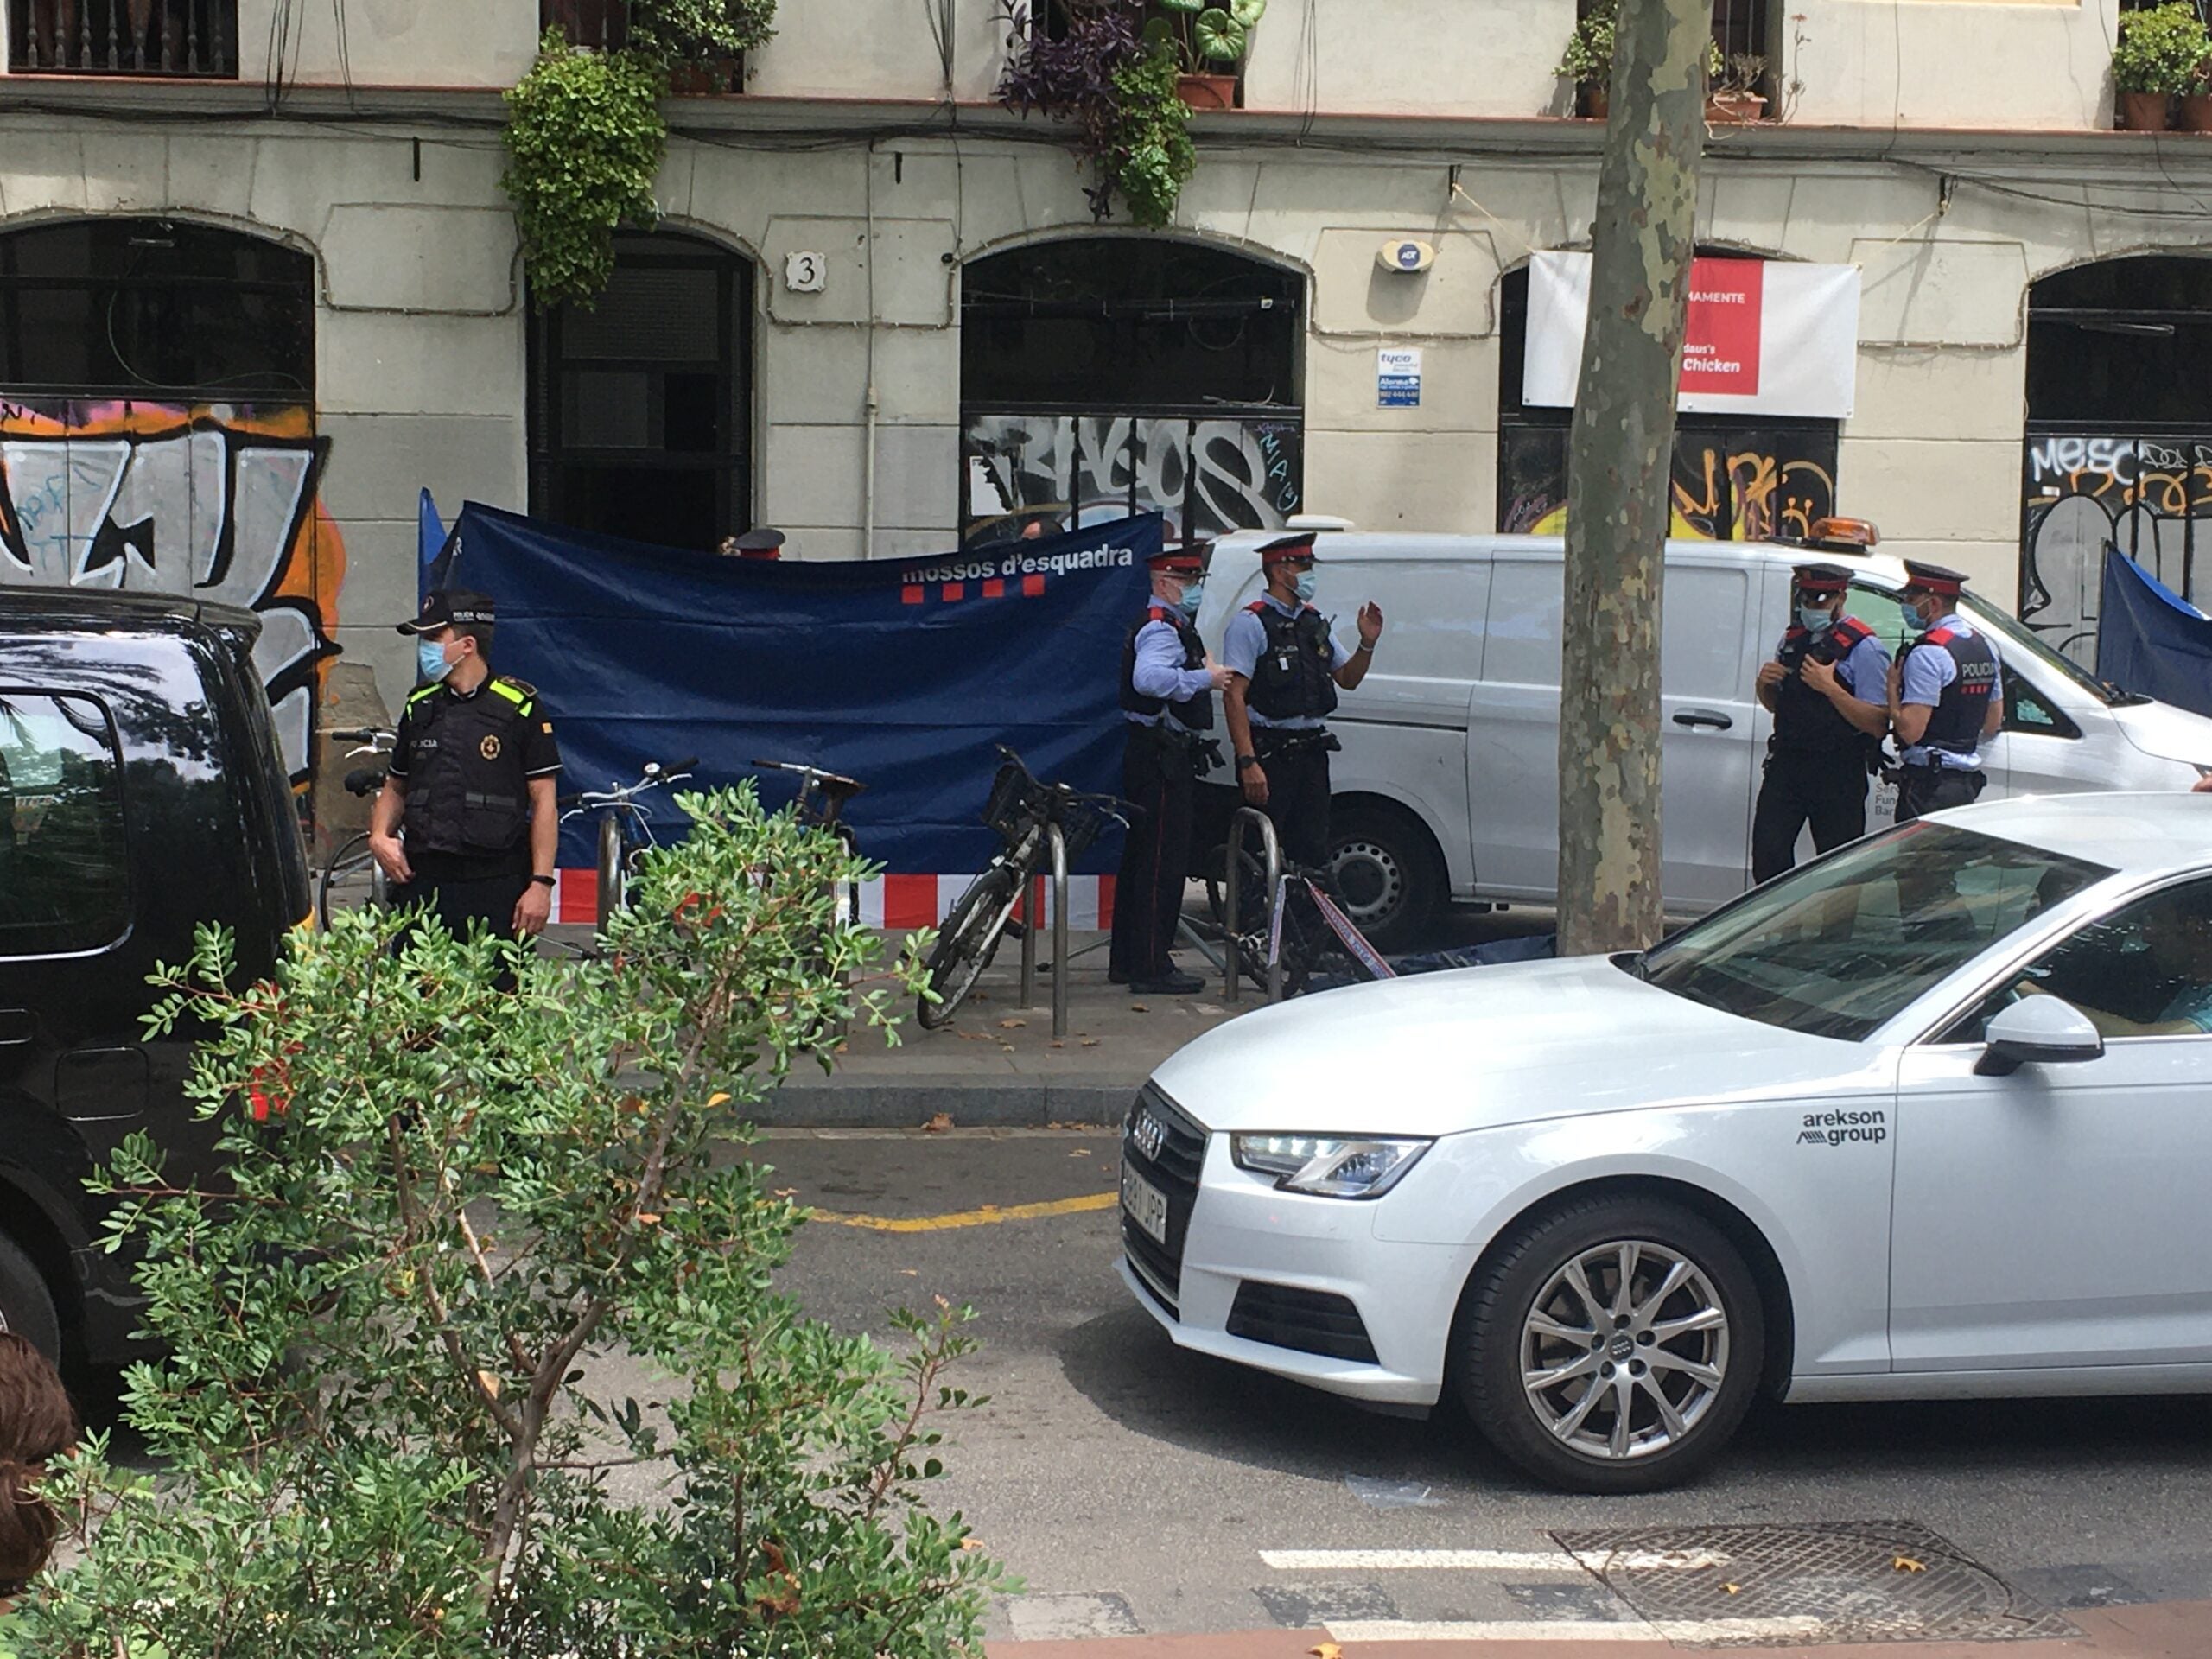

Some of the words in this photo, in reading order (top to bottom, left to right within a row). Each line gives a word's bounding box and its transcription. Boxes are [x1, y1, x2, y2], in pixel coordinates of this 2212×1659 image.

[798, 257, 815, 284] 3
[1683, 358, 1740, 372] Chicken
[902, 560, 995, 582] mossos
[1001, 543, 1133, 576] d'esquadra
[1803, 1109, 1885, 1128] arekson
[1827, 1127, 1887, 1147] group
